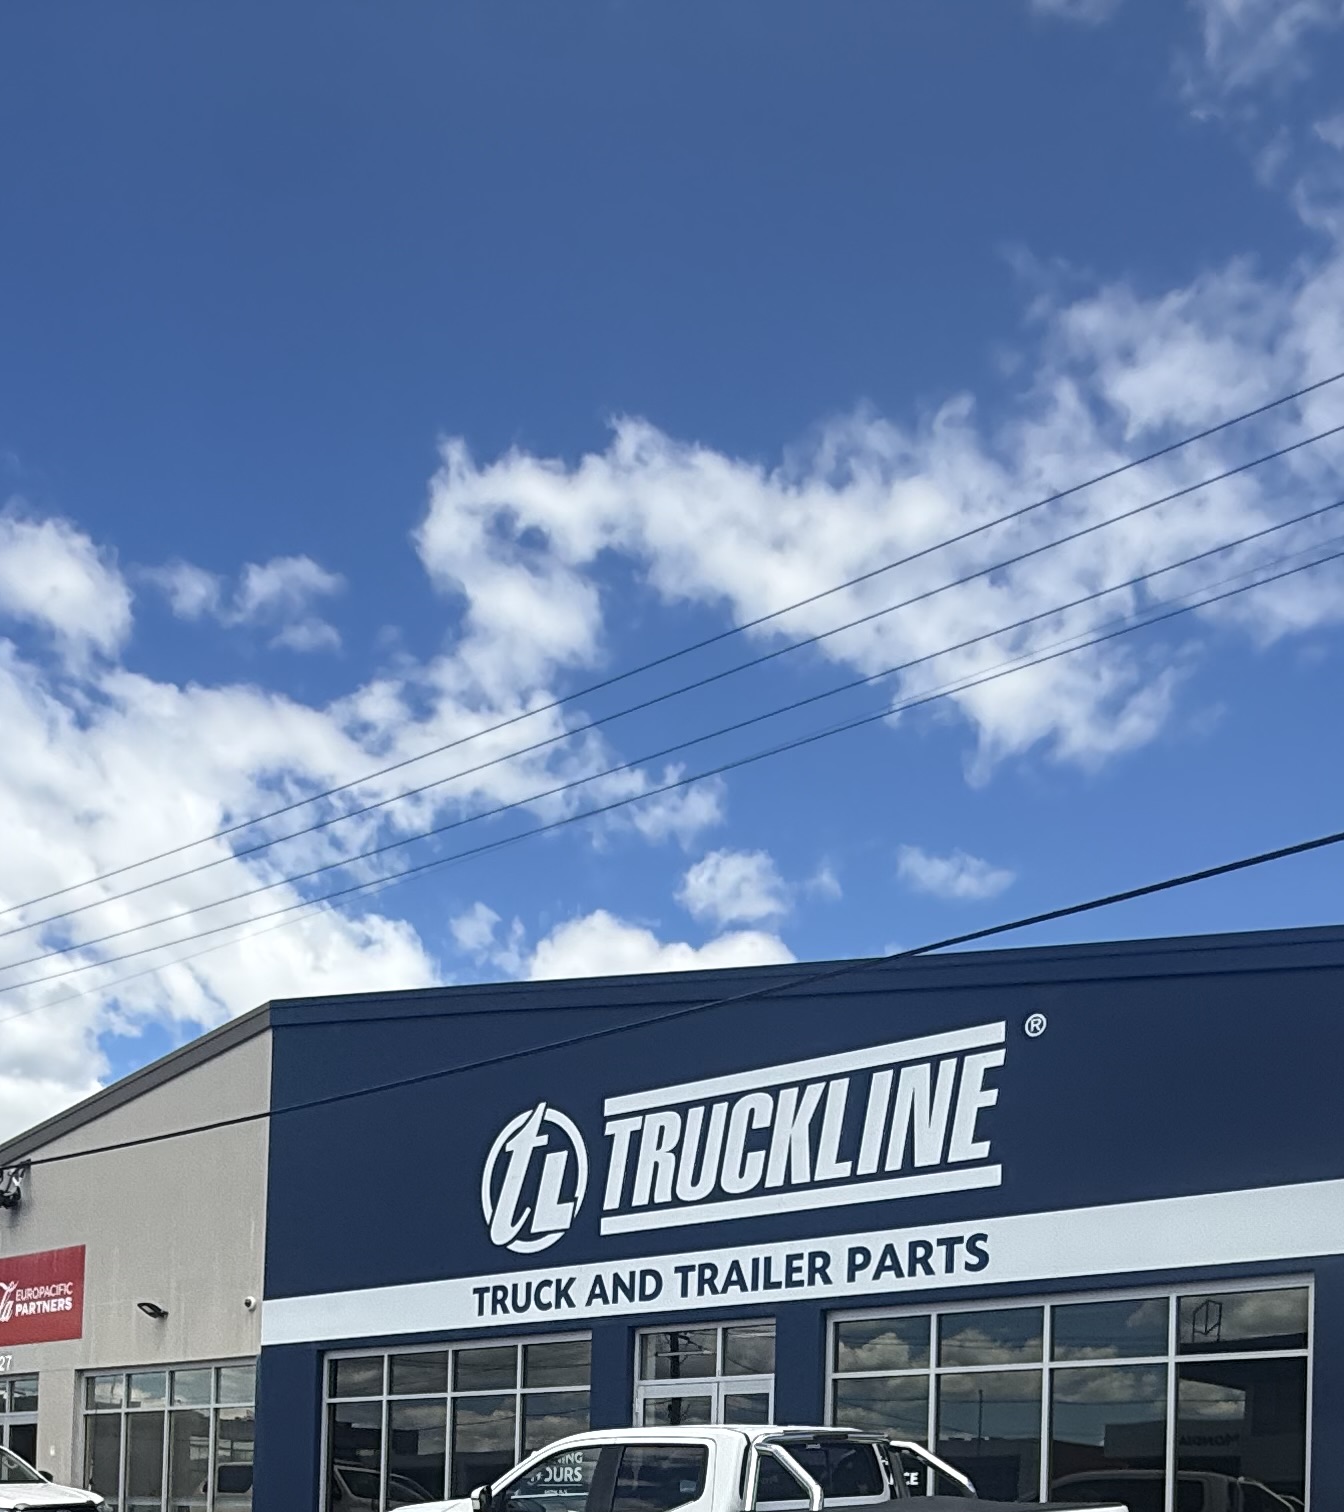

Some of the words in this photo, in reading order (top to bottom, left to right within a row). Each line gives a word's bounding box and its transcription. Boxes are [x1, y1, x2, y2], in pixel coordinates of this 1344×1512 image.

[603, 1048, 1006, 1211] TRUCKLINE
[473, 1277, 576, 1316] TRUCK
[585, 1268, 663, 1307] AND
[674, 1250, 833, 1298] TRAILER
[846, 1232, 990, 1283] PARTS
[15, 1282, 74, 1302] EUROPACIFIC
[15, 1297, 73, 1317] PARTNERS
[535, 1466, 583, 1482] OURS
